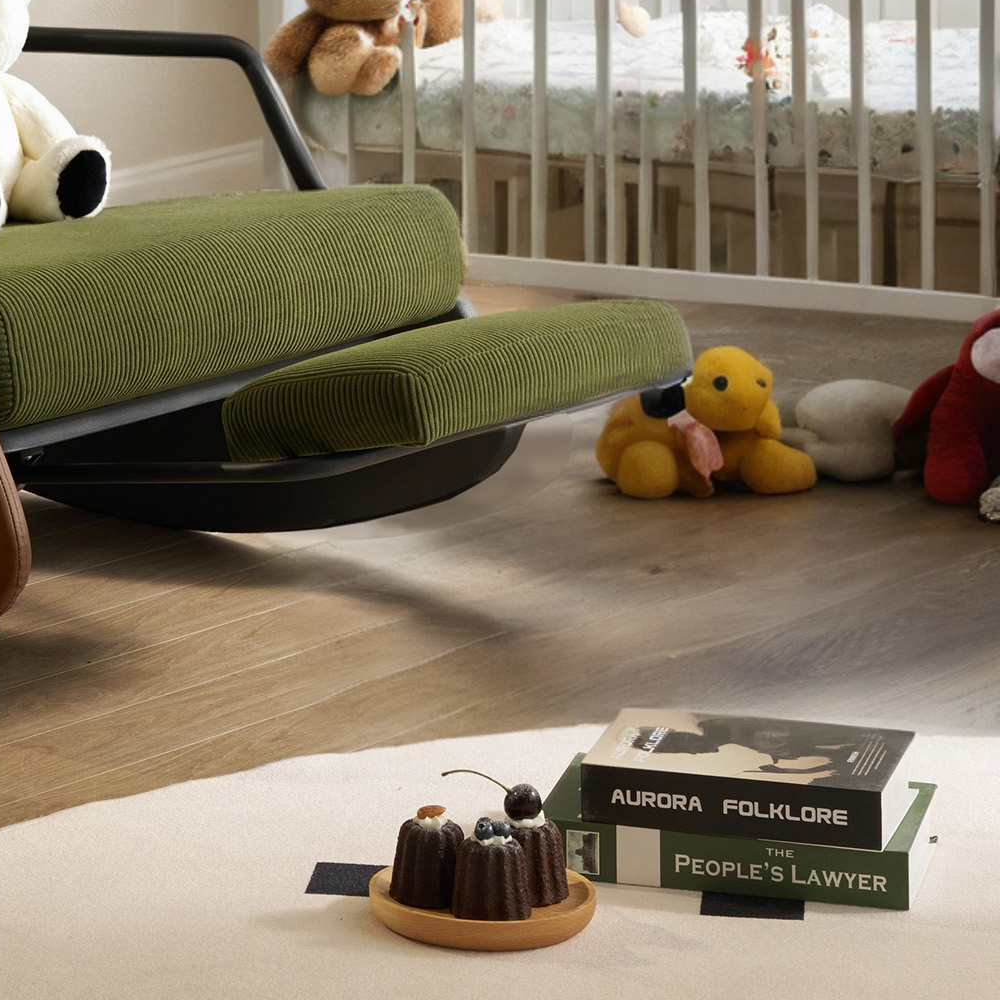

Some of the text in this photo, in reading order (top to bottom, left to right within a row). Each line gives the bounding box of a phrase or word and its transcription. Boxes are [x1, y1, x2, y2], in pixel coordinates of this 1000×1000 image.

[633, 726, 670, 762] FOLKLORE
[611, 788, 848, 826] AURORA FOLKLORE
[765, 847, 794, 859] THE
[791, 864, 888, 893] LAWYER
